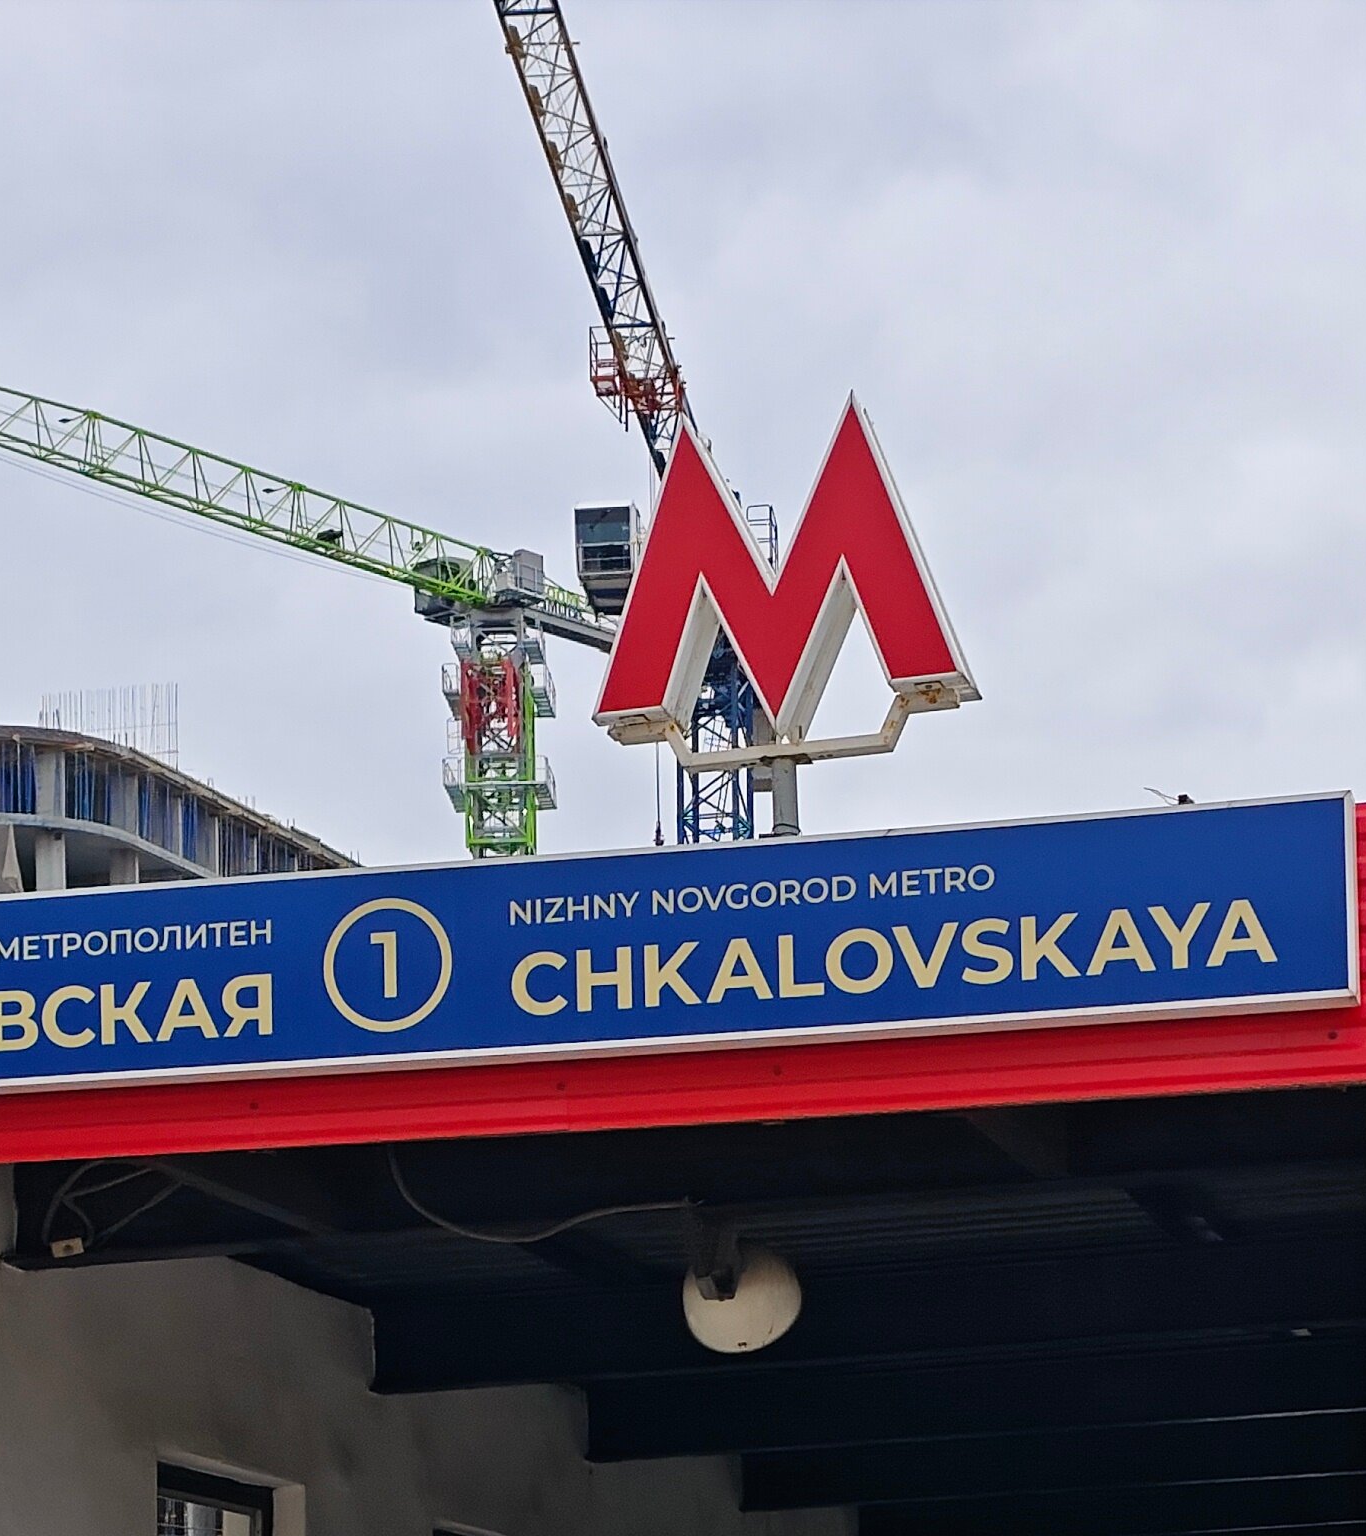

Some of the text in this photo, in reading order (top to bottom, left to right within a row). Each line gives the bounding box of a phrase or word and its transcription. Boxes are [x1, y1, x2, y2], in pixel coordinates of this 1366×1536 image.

[509, 864, 995, 926] NIZHNY NOVGOROD METRO
[370, 931, 399, 998] 1
[511, 899, 1278, 1016] CHKALOVSKAYA
